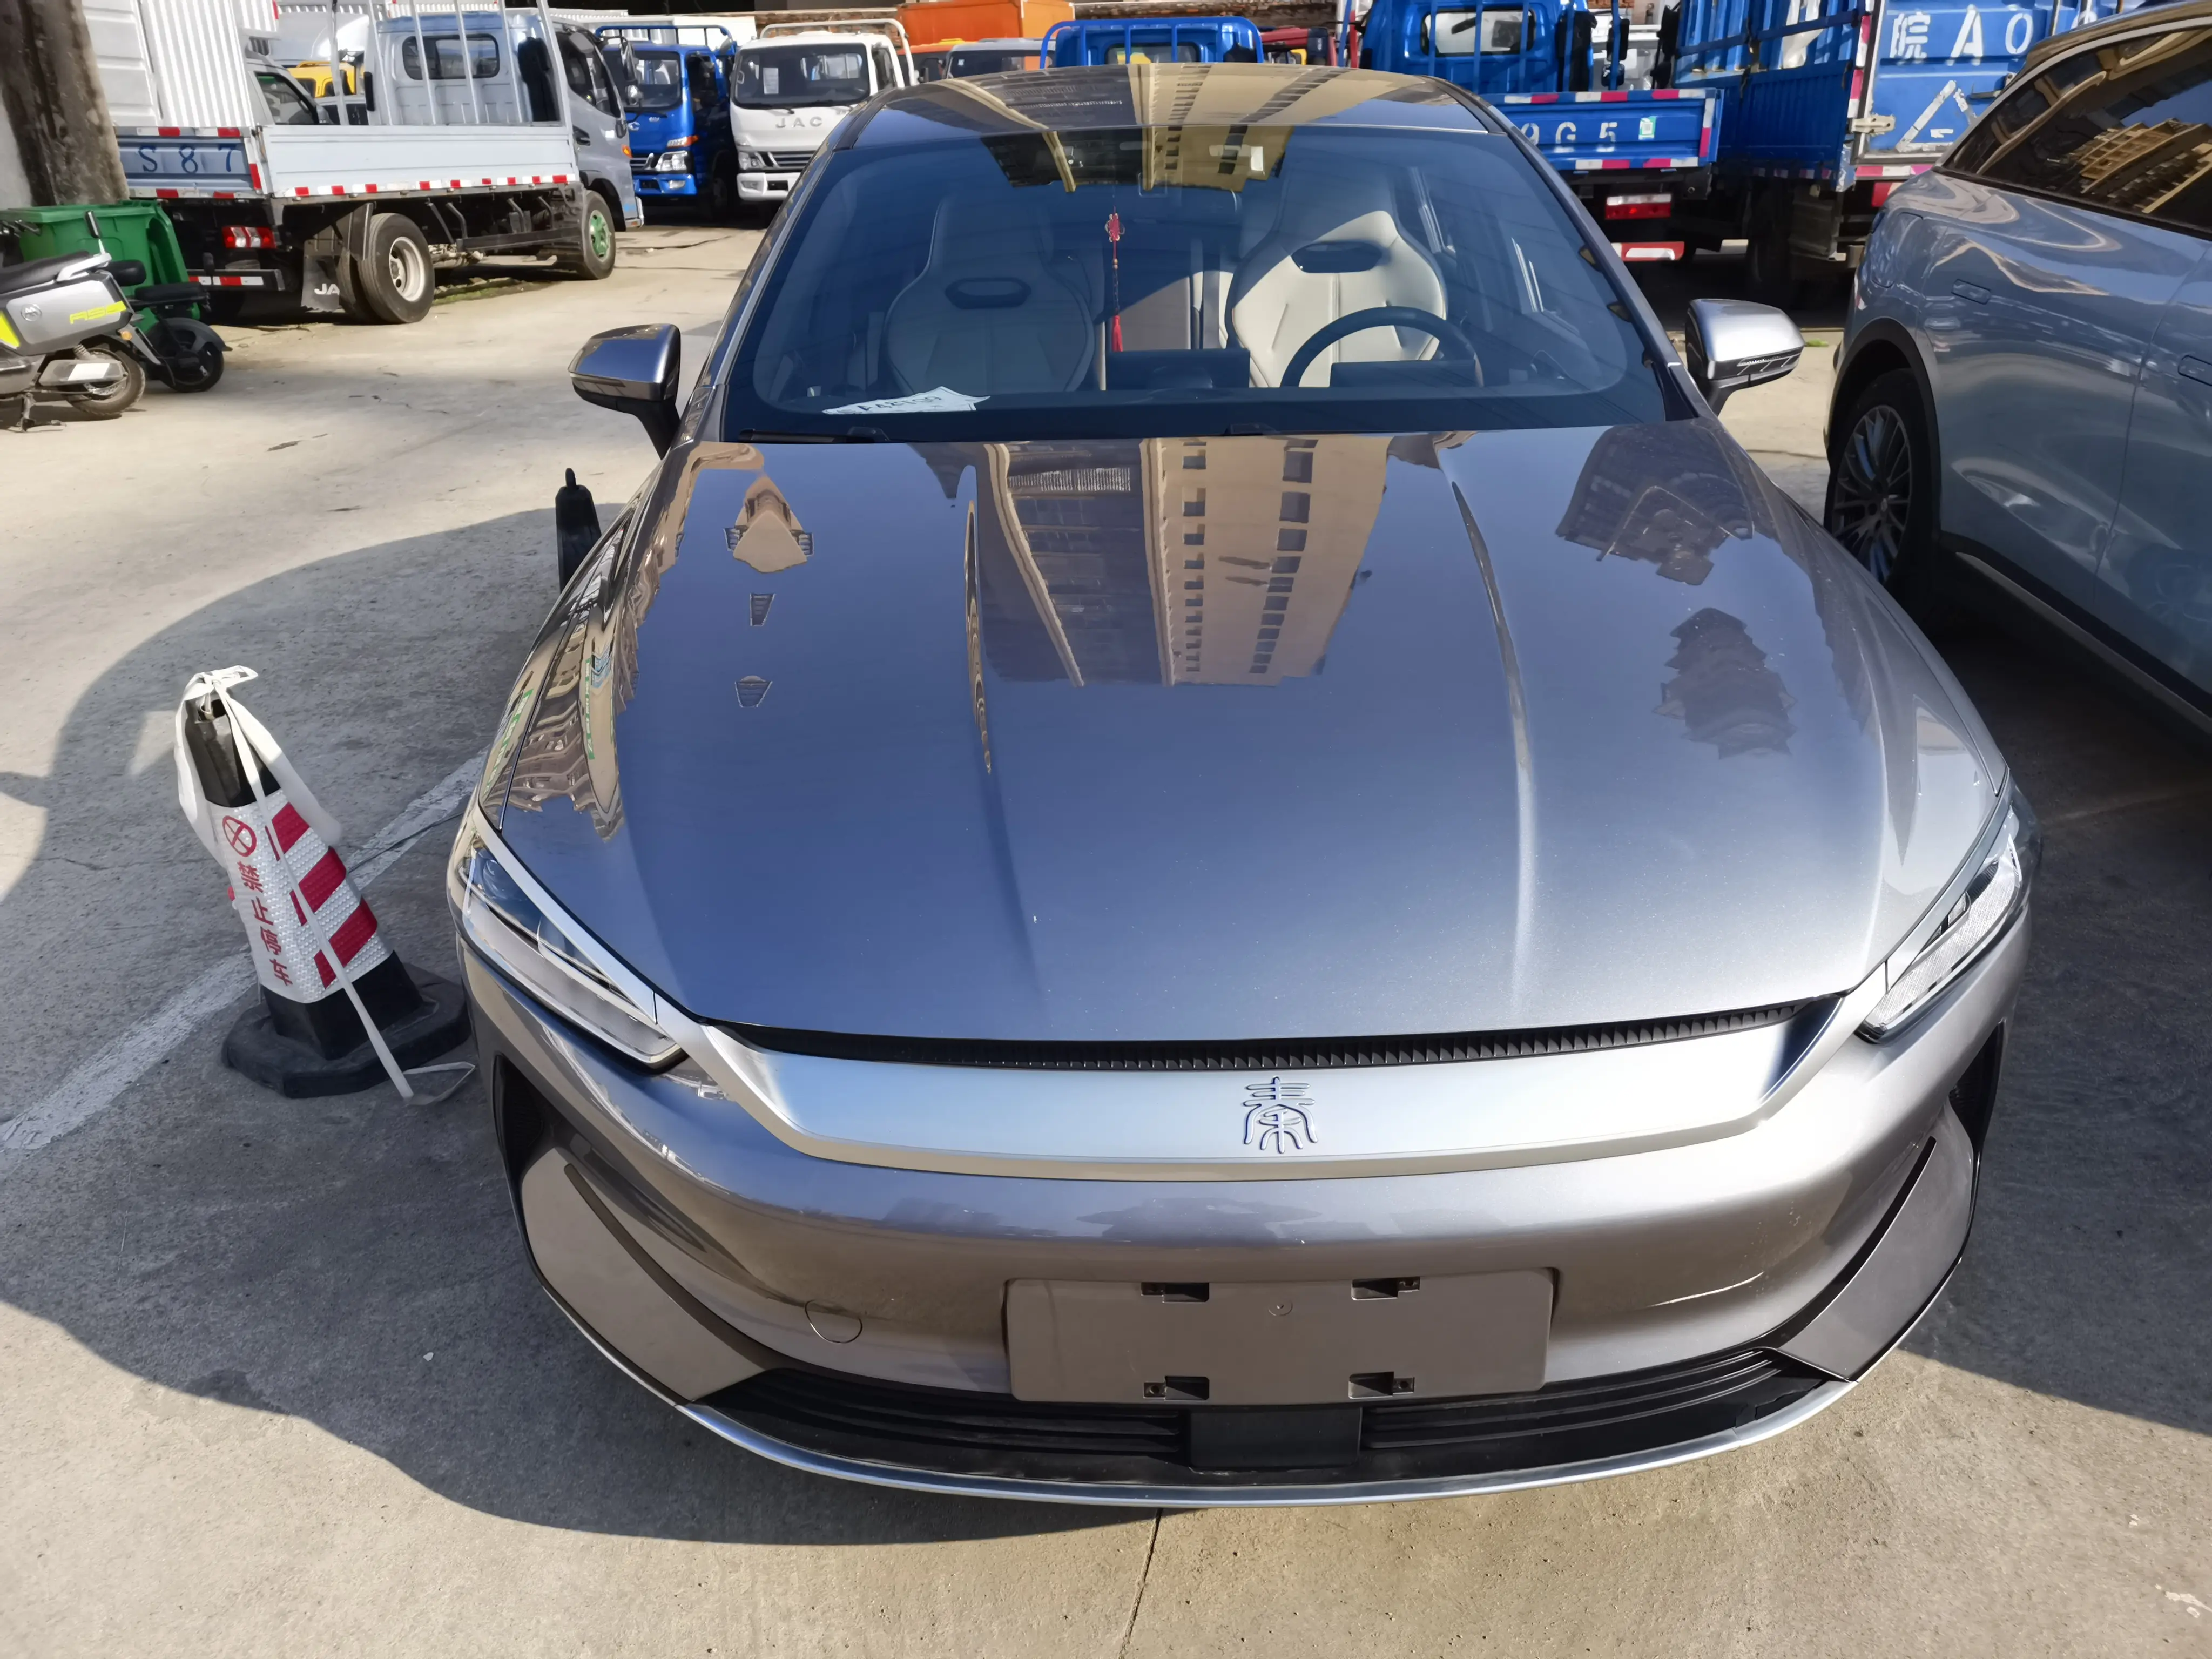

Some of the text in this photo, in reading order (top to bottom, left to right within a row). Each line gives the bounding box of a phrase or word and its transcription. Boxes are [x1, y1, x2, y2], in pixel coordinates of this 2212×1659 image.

[775, 116, 822, 128] JAC
[237, 860, 293, 986] 禁止停车
[1243, 1076, 1318, 1154] 秦
